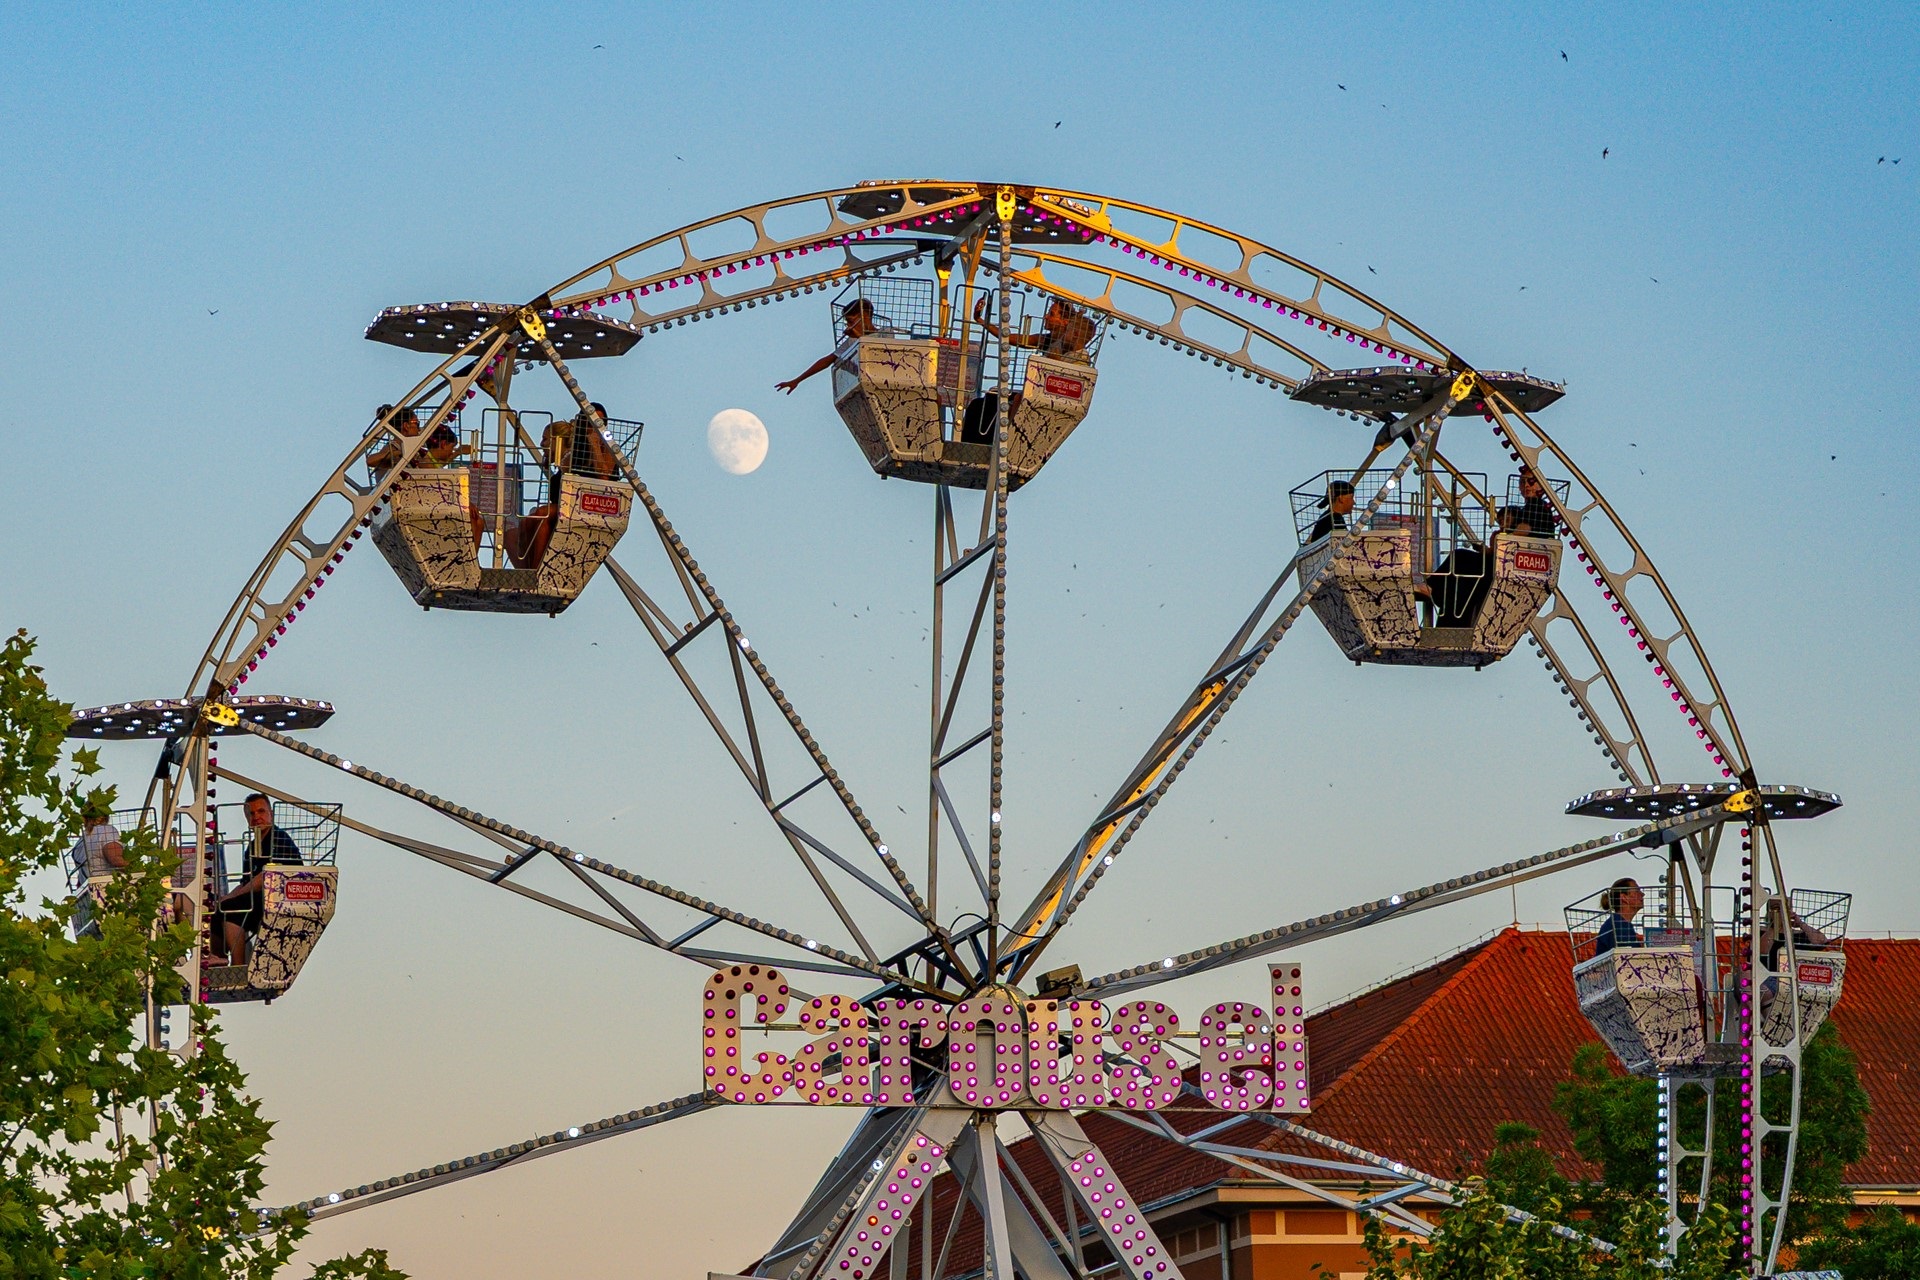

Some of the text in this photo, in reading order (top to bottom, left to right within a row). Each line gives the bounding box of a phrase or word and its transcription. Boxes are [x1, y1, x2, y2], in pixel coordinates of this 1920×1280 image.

[1518, 555, 1546, 569] PRAHA
[287, 884, 321, 894] NERUDOVA
[703, 963, 1310, 1112] Carousel
